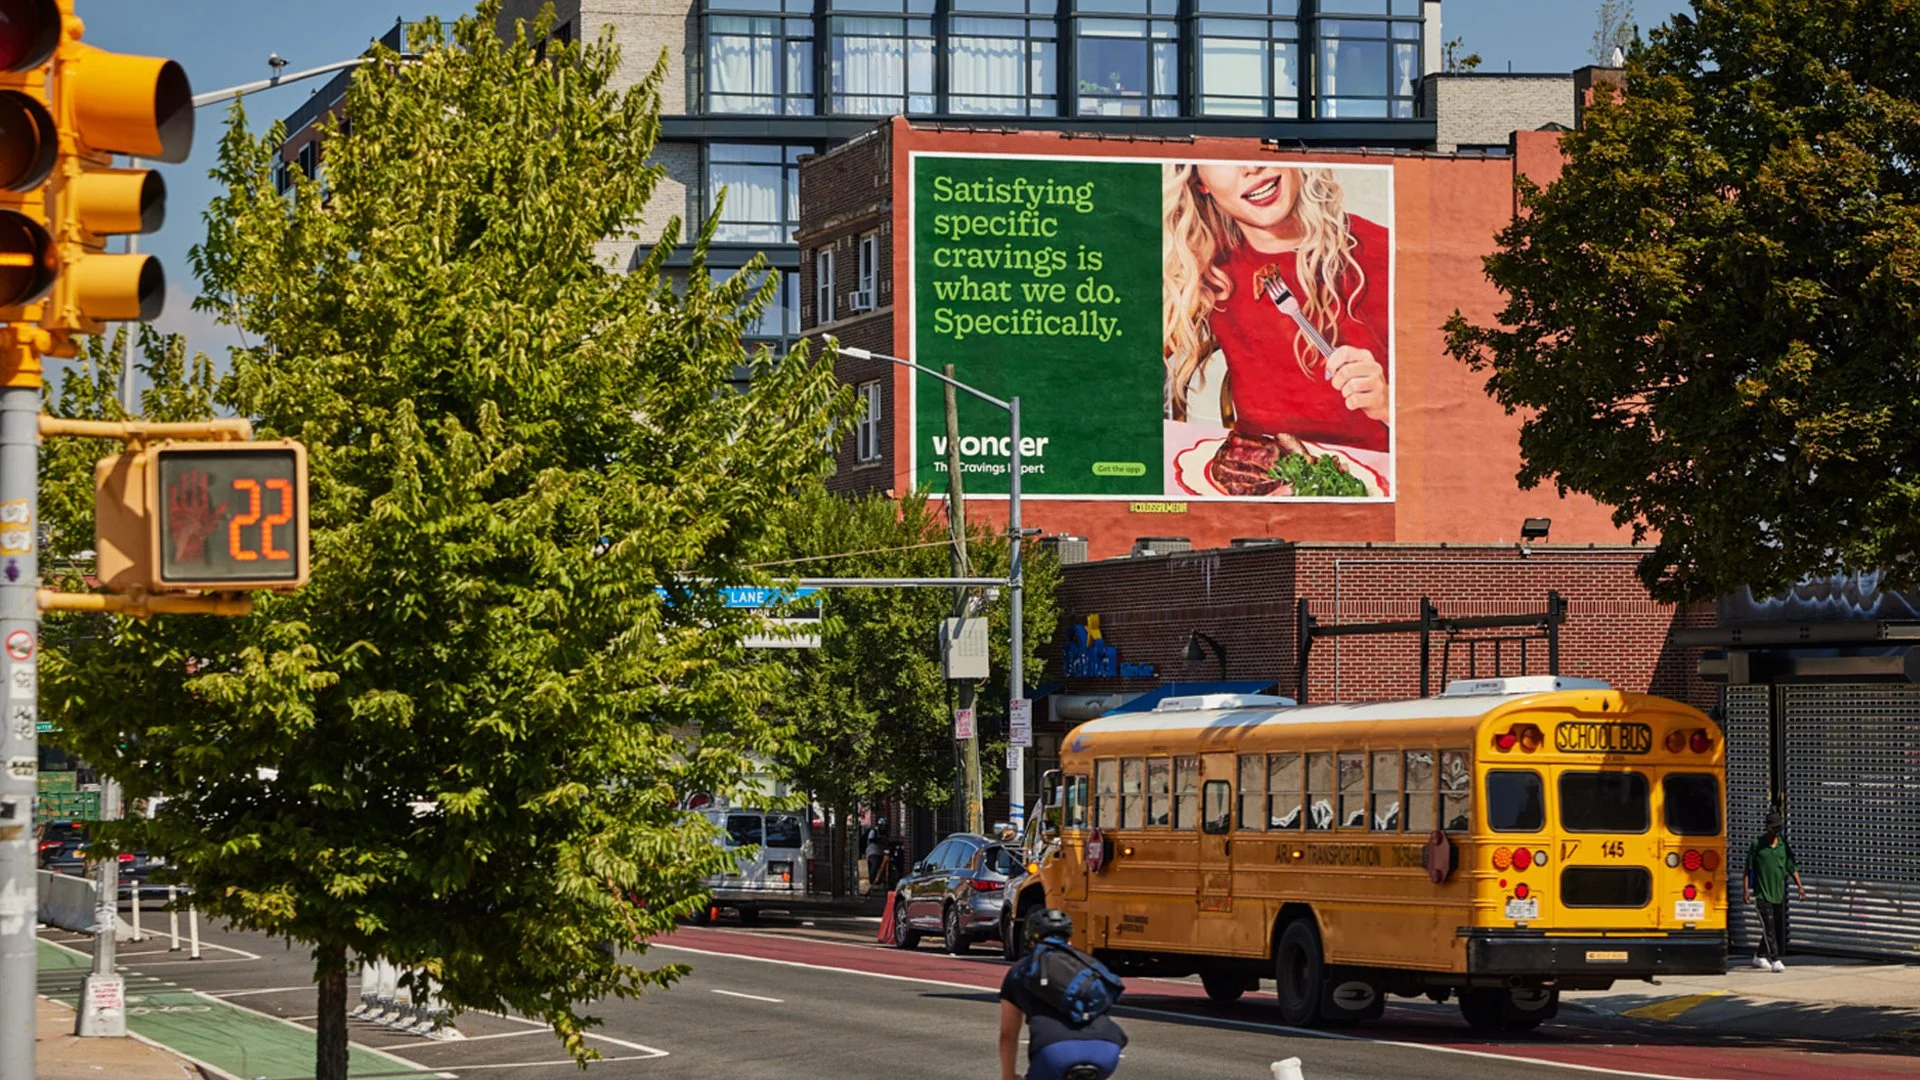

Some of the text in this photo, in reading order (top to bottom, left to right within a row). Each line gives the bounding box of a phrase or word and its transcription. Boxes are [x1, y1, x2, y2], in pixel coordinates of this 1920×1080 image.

[934, 176, 1094, 213] Satisfying
[934, 209, 1057, 240] specific
[934, 243, 1102, 277] cravings is
[934, 275, 1120, 304] what we do.
[934, 308, 1122, 342] Specifically.
[957, 462, 1005, 475] Cravings
[1098, 465, 1140, 474] Get the app
[228, 479, 293, 560] 22
[732, 592, 765, 604] LANE
[1558, 724, 1649, 751] SCHOOL BUS
[1306, 844, 1382, 867] TRANSPORTATION
[1601, 841, 1625, 858] 145
